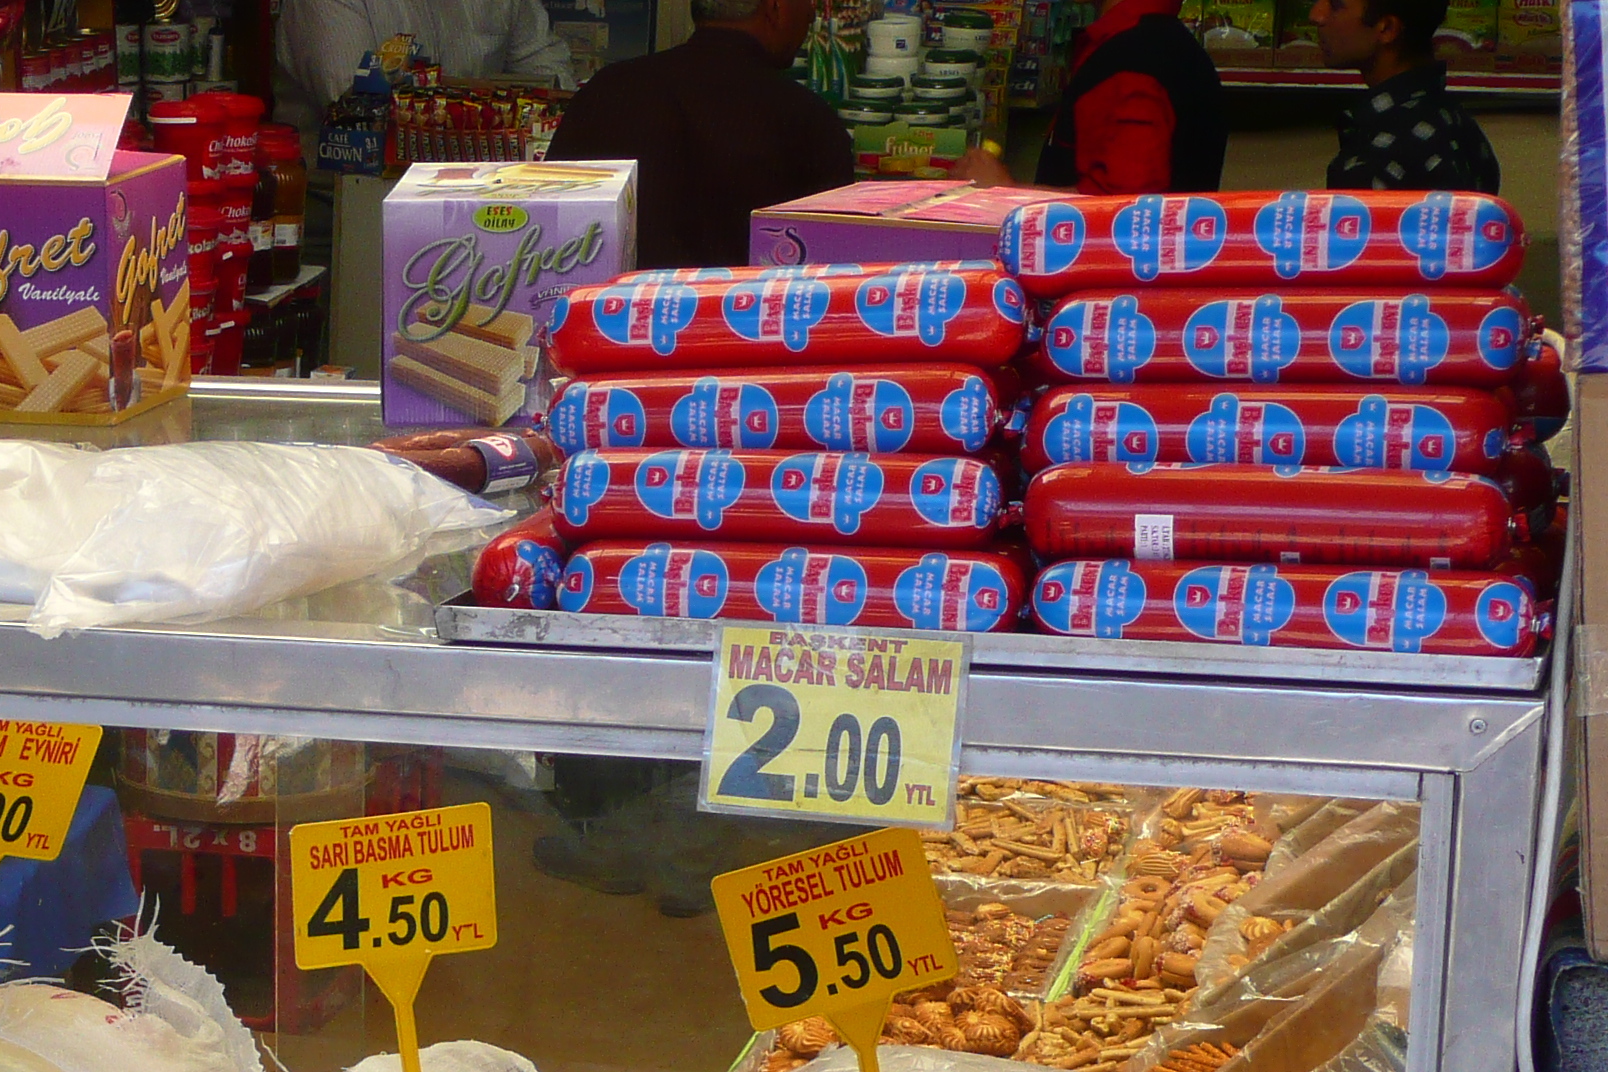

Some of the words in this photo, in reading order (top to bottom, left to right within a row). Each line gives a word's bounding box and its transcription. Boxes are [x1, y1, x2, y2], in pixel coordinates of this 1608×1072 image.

[319, 142, 362, 162] CROWN
[486, 206, 512, 216] ESES
[1132, 210, 1141, 250] SALAM
[1142, 209, 1152, 251] MACAR
[116, 191, 186, 324] Gofret
[398, 220, 603, 343] Gofret
[1117, 317, 1127, 361] MACAR
[1128, 319, 1137, 360] SALAM
[1261, 317, 1271, 361] MACAR
[1273, 319, 1283, 360] SALAM
[1409, 318, 1419, 361] MACAR
[1420, 319, 1430, 360] SALAM
[834, 397, 843, 439] MACAR
[784, 567, 794, 609] MACAR
[923, 573, 934, 615] MACAR
[1105, 575, 1116, 616] MACAR
[1117, 577, 1128, 615] SALAM
[1253, 581, 1265, 623] MACAR
[1265, 582, 1276, 621] SALAM
[1405, 587, 1415, 629] MACAR
[1416, 588, 1428, 629] SALAM
[728, 644, 837, 687] MACAR
[845, 653, 953, 695] SALAM
[15, 722, 63, 738] YAĞLI
[716, 684, 902, 806] 2.00
[904, 783, 936, 806] YTL
[26, 833, 50, 849] YTL
[310, 844, 349, 869] SARI
[354, 837, 414, 865] BASMA
[417, 824, 474, 854] TULUM
[339, 821, 380, 838] TAM
[385, 814, 442, 831] YAĞLI
[382, 869, 433, 888] KG
[763, 860, 805, 882] TAM
[808, 841, 869, 866] YAĞLI
[742, 871, 834, 918] YÖRESEL
[834, 850, 904, 891] TULUM
[307, 868, 449, 950] 4.50
[818, 902, 874, 930] KG
[751, 912, 903, 1008] 5.50
[907, 954, 943, 976] YTL
